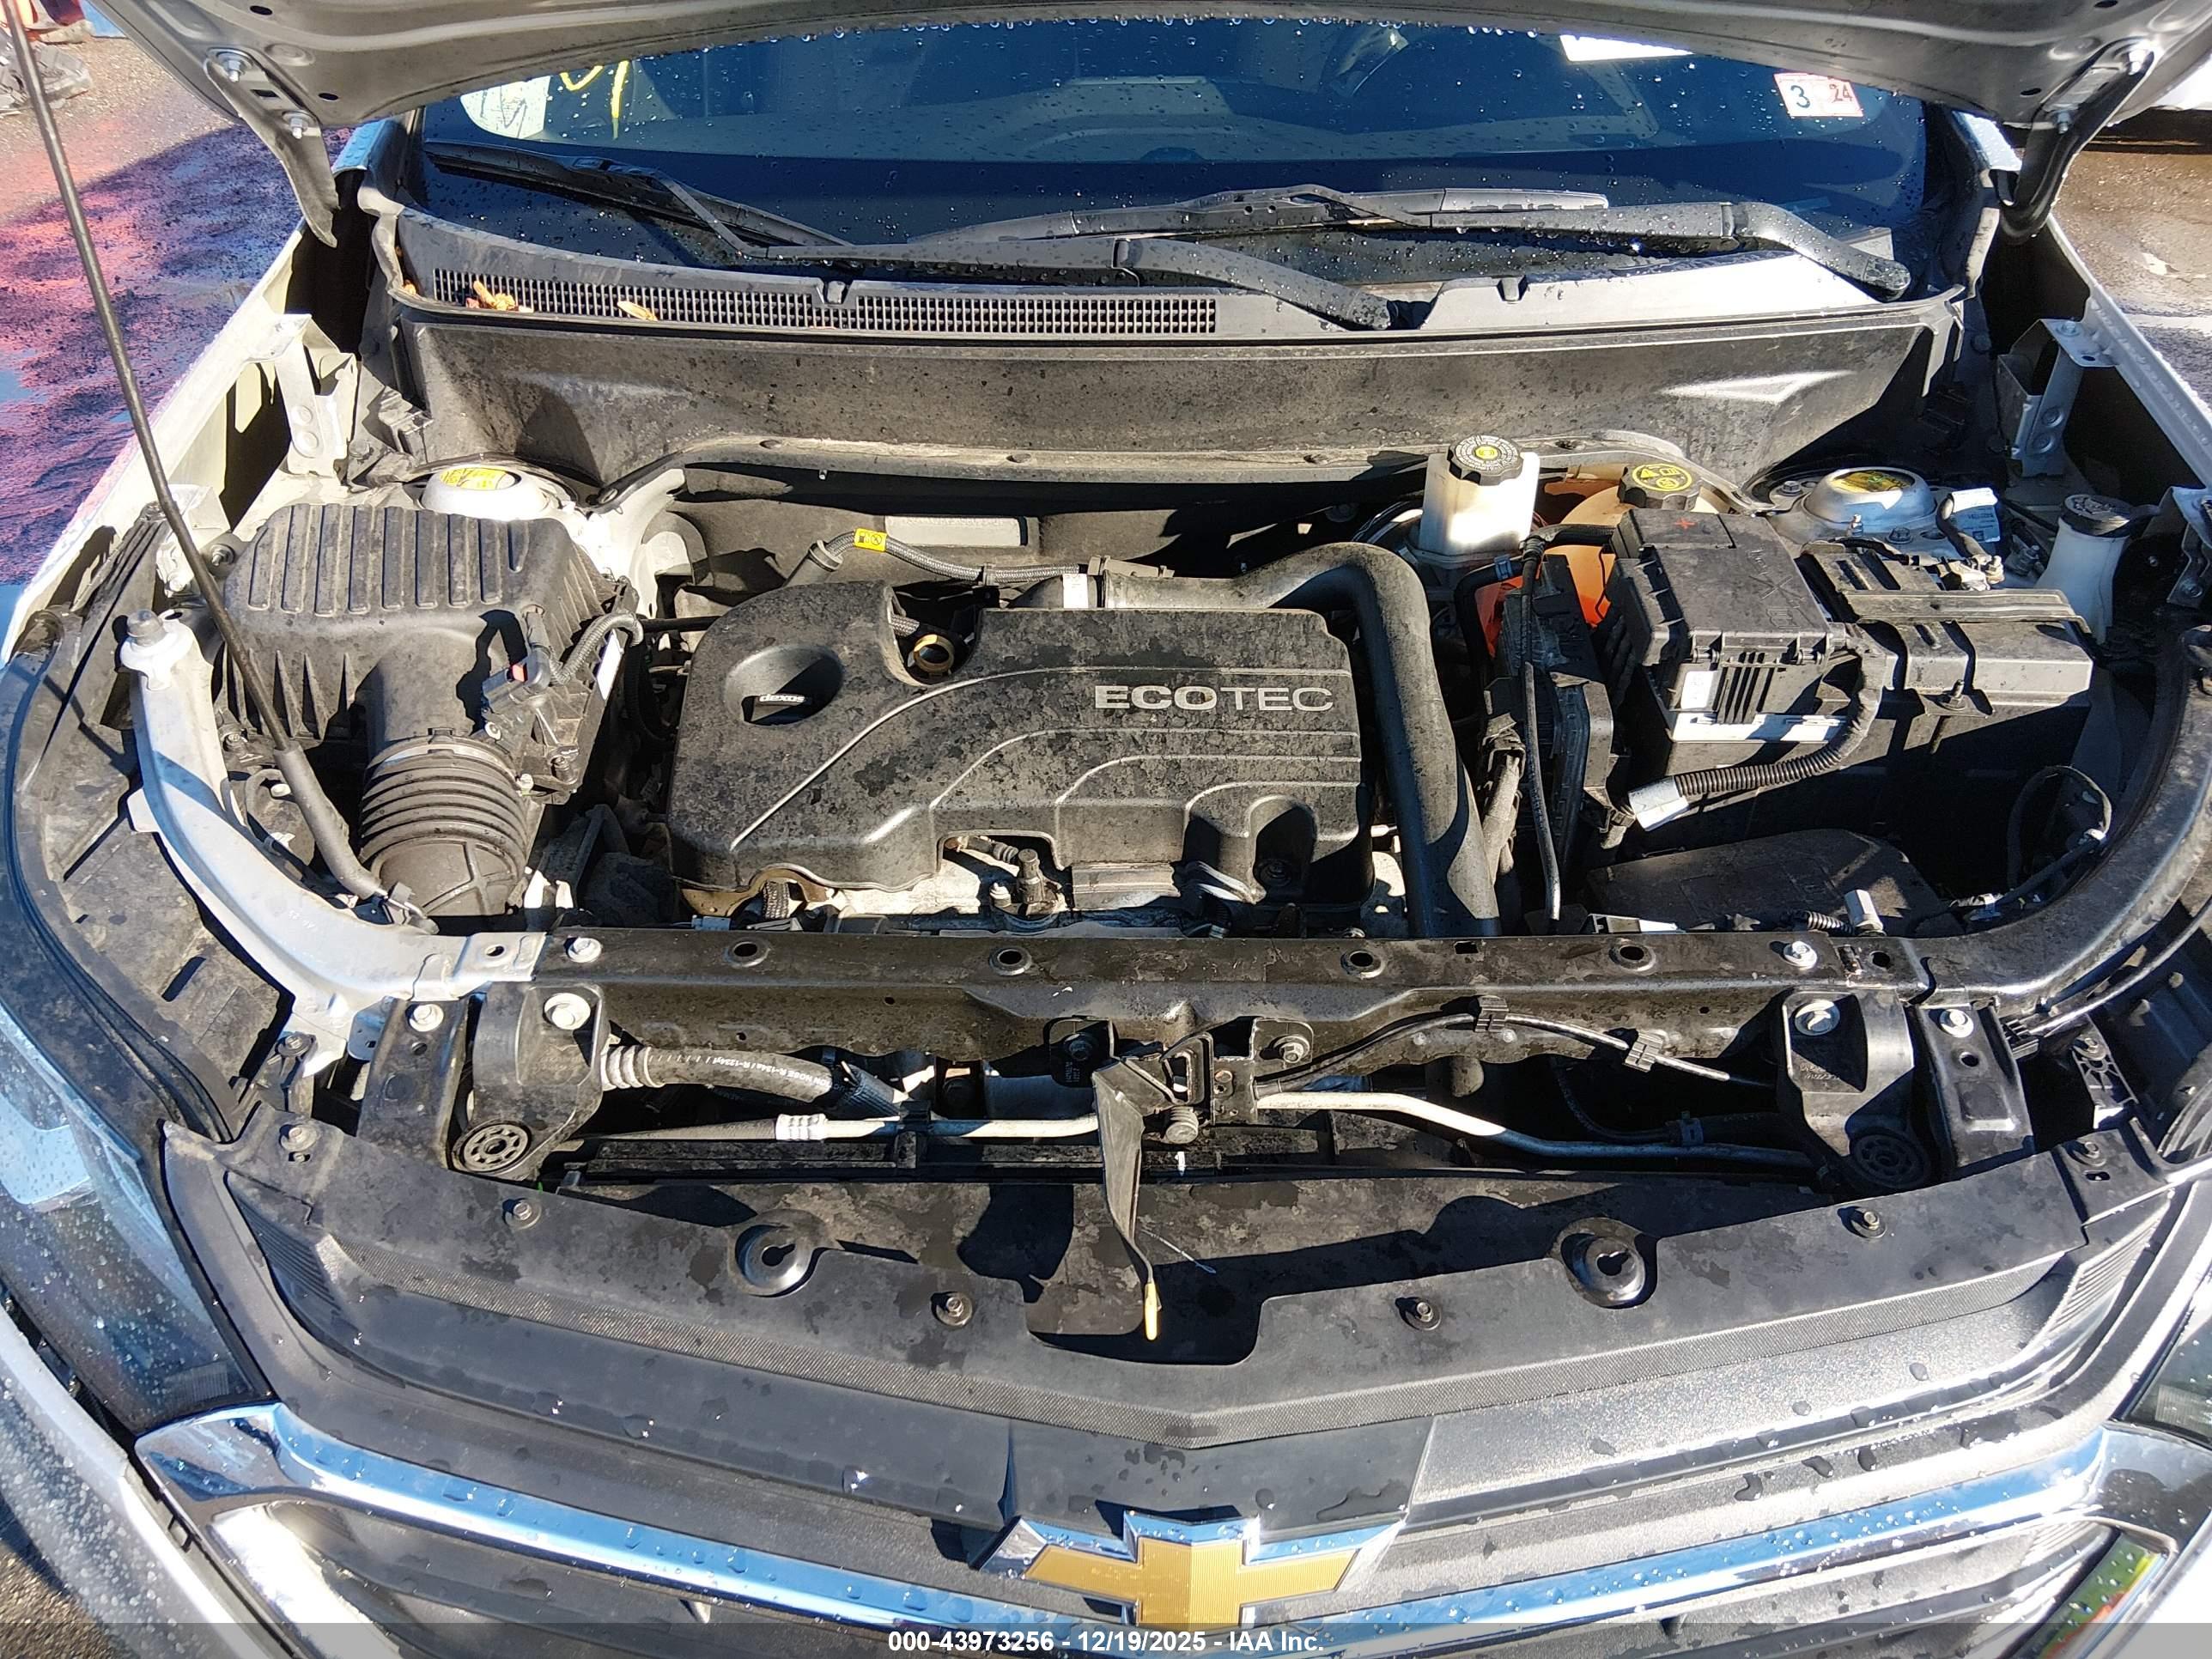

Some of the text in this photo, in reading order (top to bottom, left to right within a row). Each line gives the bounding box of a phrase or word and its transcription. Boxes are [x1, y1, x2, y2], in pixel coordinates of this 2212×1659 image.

[1790, 82, 1853, 109] 3 24
[759, 693, 805, 703] dexos
[1094, 685, 1334, 712] ECOTEC
[787, 1070, 812, 1084] HOSE
